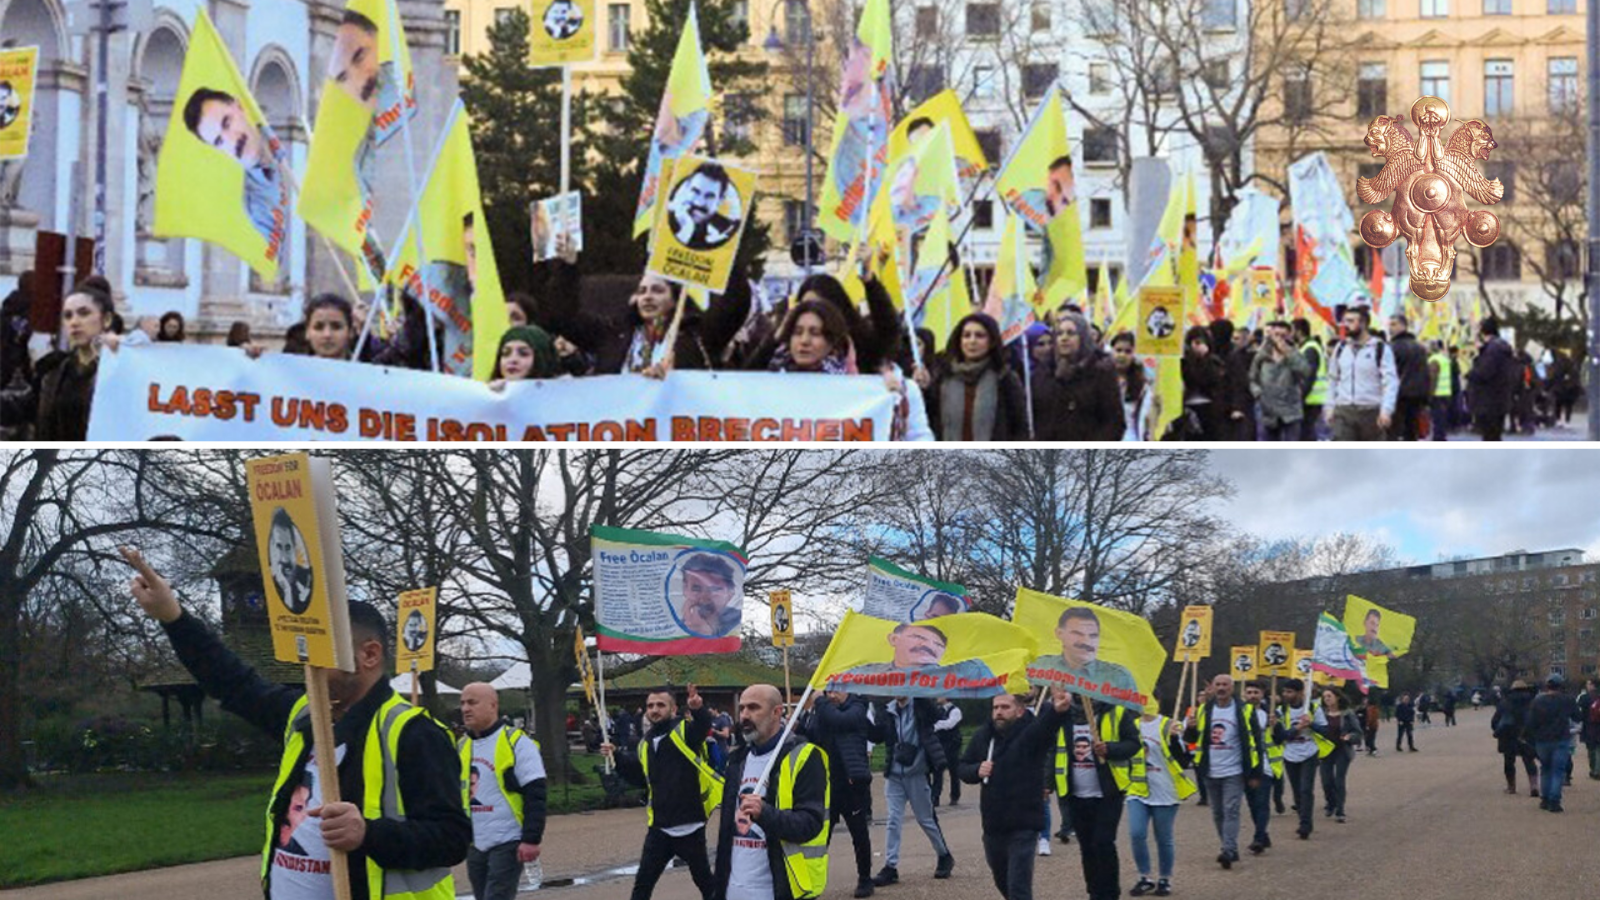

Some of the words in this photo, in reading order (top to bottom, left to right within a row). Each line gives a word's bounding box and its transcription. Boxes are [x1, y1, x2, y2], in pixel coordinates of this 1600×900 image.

[148, 383, 261, 422] LASST
[271, 396, 349, 433] UNS
[359, 408, 417, 441] DIE
[670, 416, 874, 441] BRECHEN
[600, 551, 627, 564] Free
[909, 670, 940, 688] For
[1077, 677, 1099, 692] For
